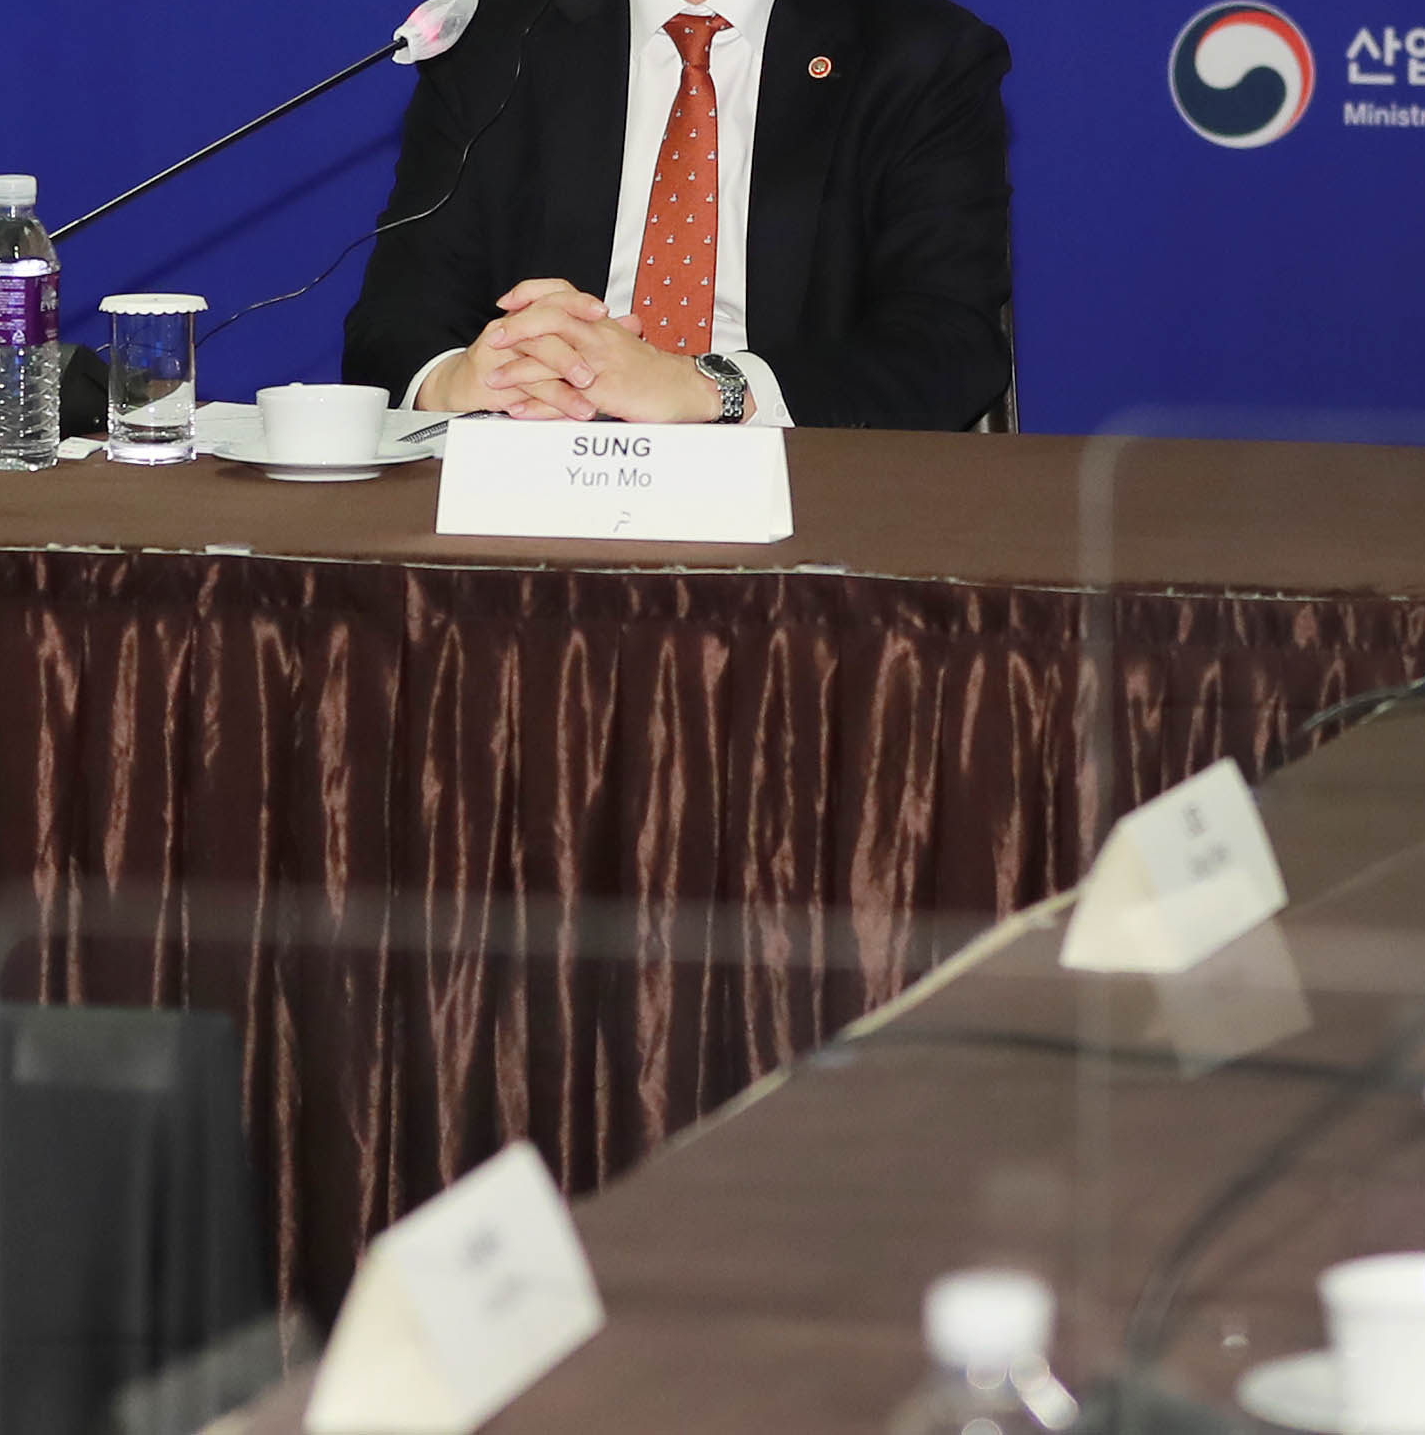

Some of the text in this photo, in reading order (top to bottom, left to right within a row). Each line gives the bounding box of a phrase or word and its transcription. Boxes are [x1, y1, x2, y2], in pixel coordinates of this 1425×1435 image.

[571, 435, 653, 459] SUNG
[565, 466, 653, 488] Yun Mo
